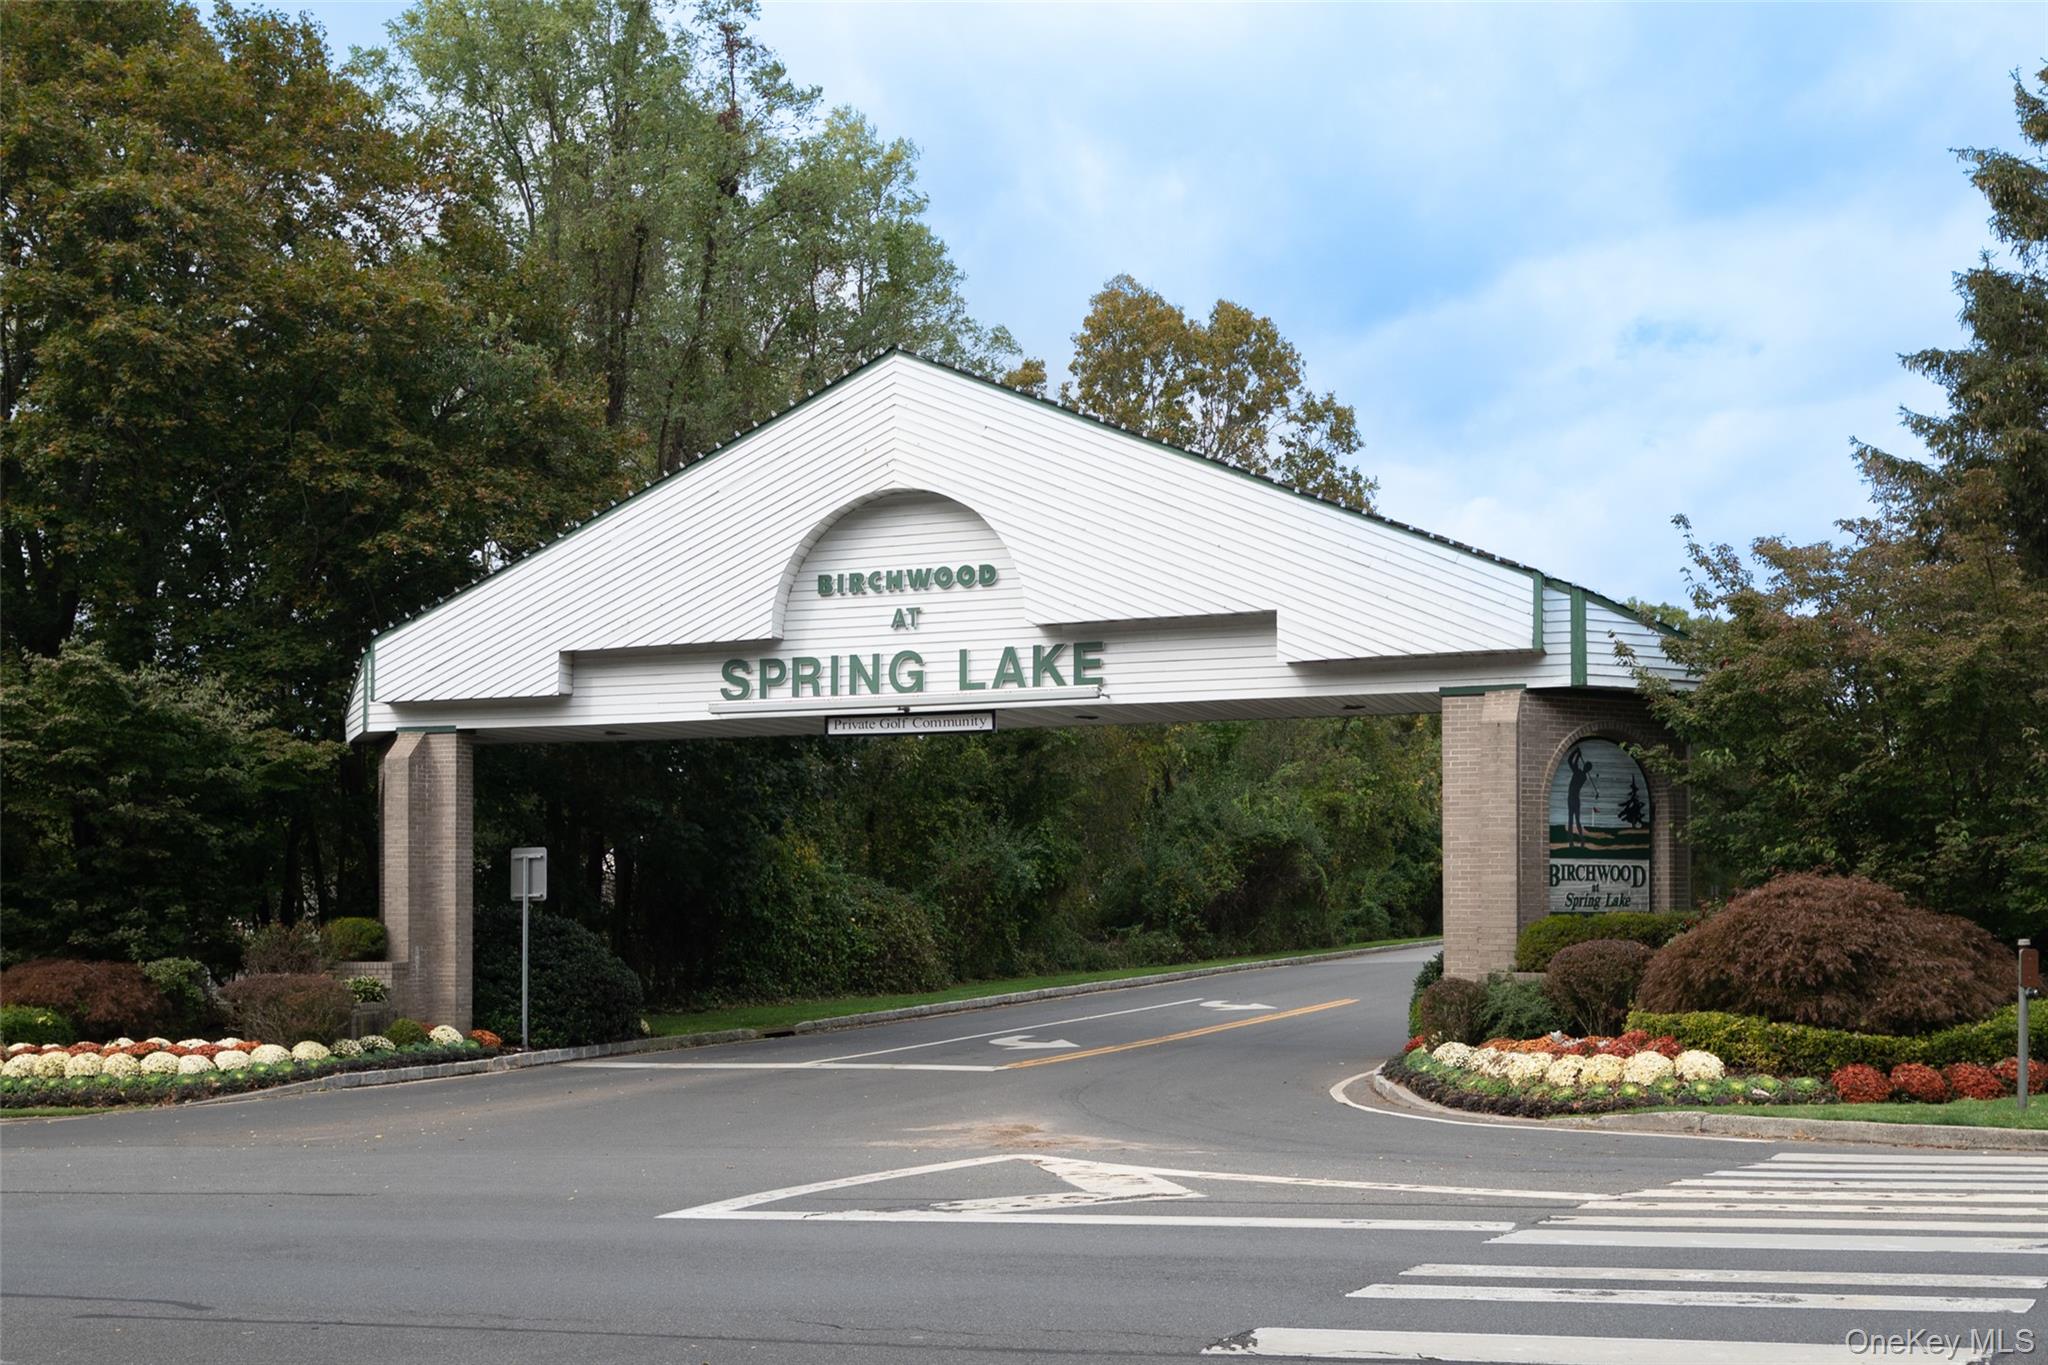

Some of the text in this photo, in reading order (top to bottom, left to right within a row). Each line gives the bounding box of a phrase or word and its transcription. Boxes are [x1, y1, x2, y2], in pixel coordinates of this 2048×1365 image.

[818, 564, 999, 596] BIRCHWOOD
[891, 607, 921, 630] AT
[720, 641, 1106, 701] SPRING LAKE
[833, 714, 988, 732] Private Golf Community
[1549, 864, 1646, 888] BIRCHWOOD
[1565, 892, 1631, 910] Spring Lake
